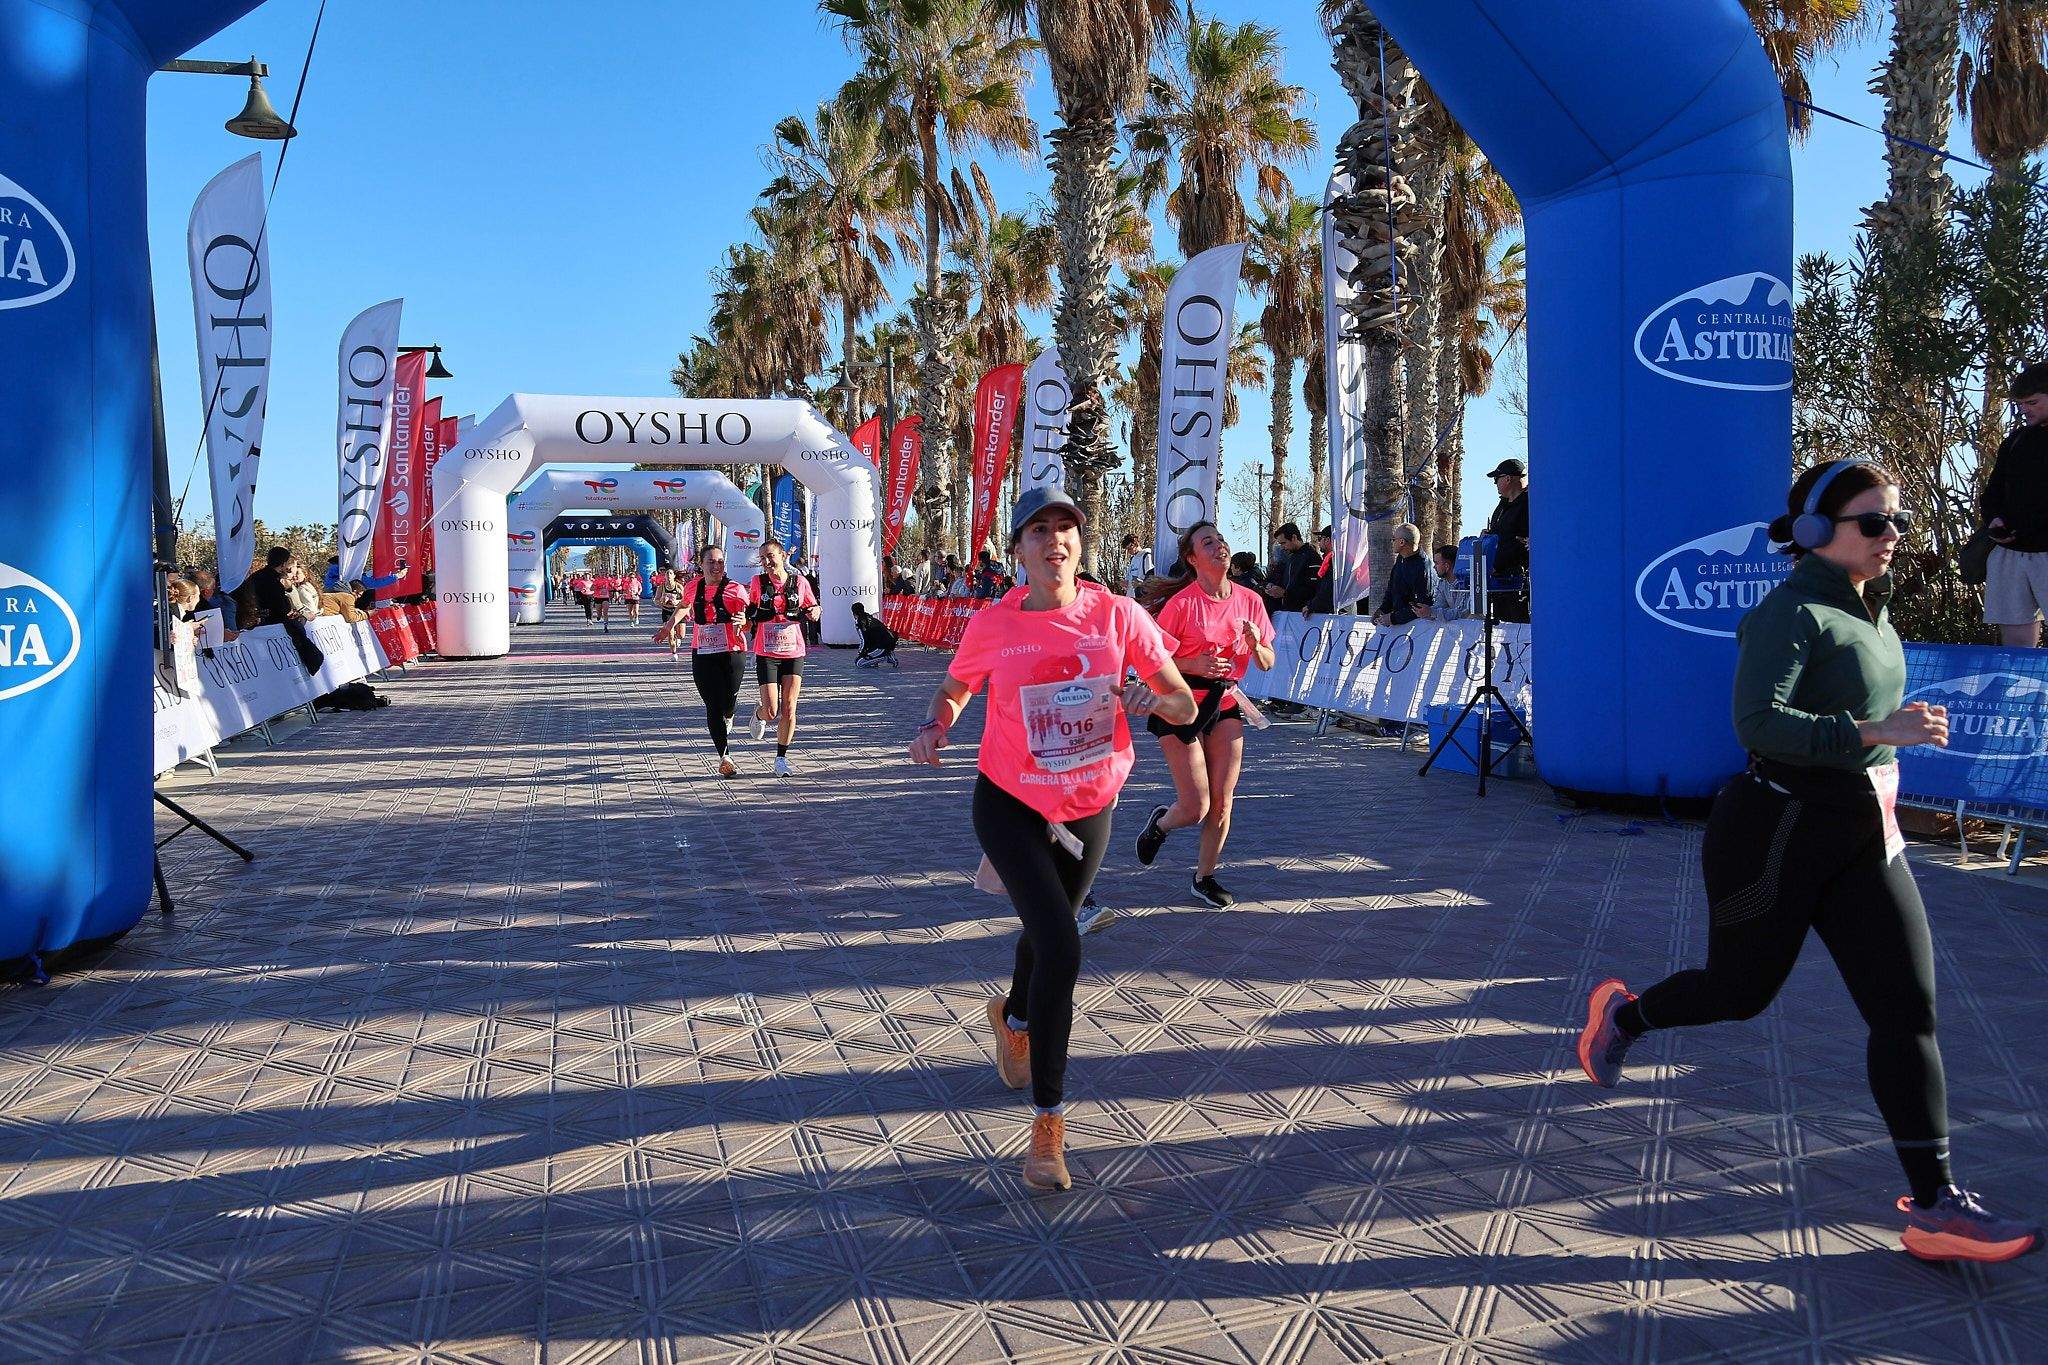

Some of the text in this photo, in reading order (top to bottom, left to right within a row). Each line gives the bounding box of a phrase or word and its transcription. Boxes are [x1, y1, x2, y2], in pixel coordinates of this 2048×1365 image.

[1697, 313, 1767, 325] CENTRAL
[1165, 294, 1223, 535] OYSHO
[392, 383, 411, 487] Santander
[575, 409, 752, 447] OYSHO
[1031, 379, 1067, 490] SHO
[982, 389, 1007, 487] Santander
[343, 345, 387, 549] OYSHO
[464, 447, 521, 462] OYSHO
[801, 449, 850, 461] OYSHO
[892, 435, 914, 507] Santander
[441, 519, 494, 533] OYSHO
[564, 522, 635, 530] VOLVO
[829, 518, 875, 531] OYSHO
[390, 518, 410, 579] ports
[1697, 562, 1767, 574] CENTRAL
[442, 590, 495, 605] OYSHO
[832, 584, 876, 597] OYSHO
[1001, 644, 1041, 657] OYSHO
[1299, 626, 1414, 673] OYSHO
[203, 643, 258, 689] OYSHO
[1056, 694, 1091, 703] ASTURIANA
[1936, 699, 2000, 711] CENTRAL
[1061, 718, 1094, 736] 016
[1020, 773, 1060, 785] CARRERA
